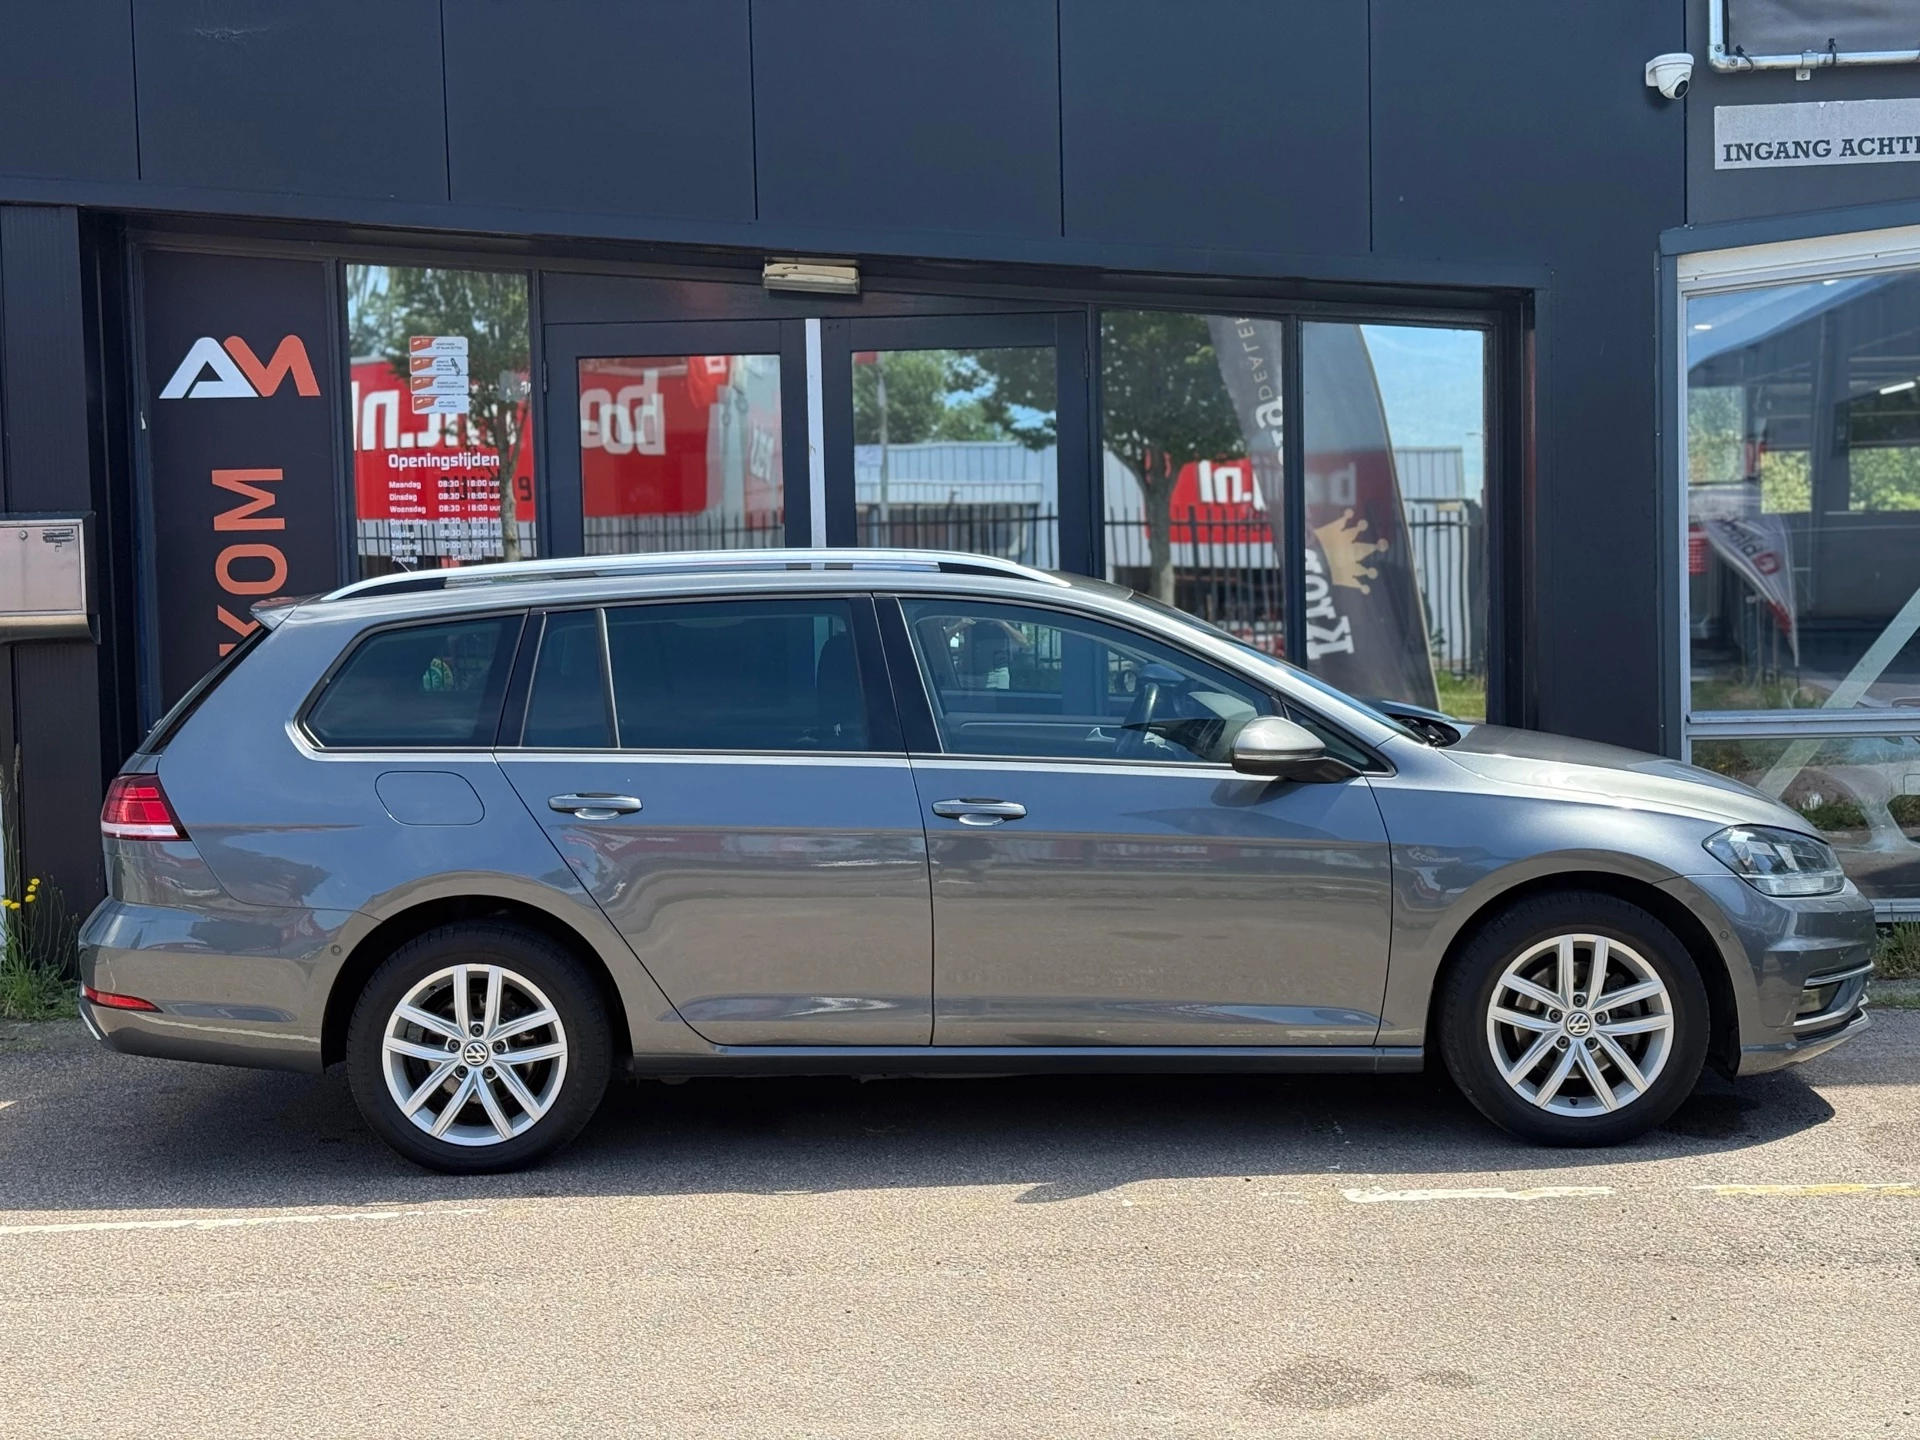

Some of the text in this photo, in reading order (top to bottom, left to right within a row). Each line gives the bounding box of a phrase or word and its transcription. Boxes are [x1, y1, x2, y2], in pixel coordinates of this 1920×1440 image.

[1723, 139, 1832, 163] INGANG
[388, 452, 500, 471] Openingstijden
[389, 493, 418, 501] Dinsdag
[390, 506, 426, 514] Woensdag
